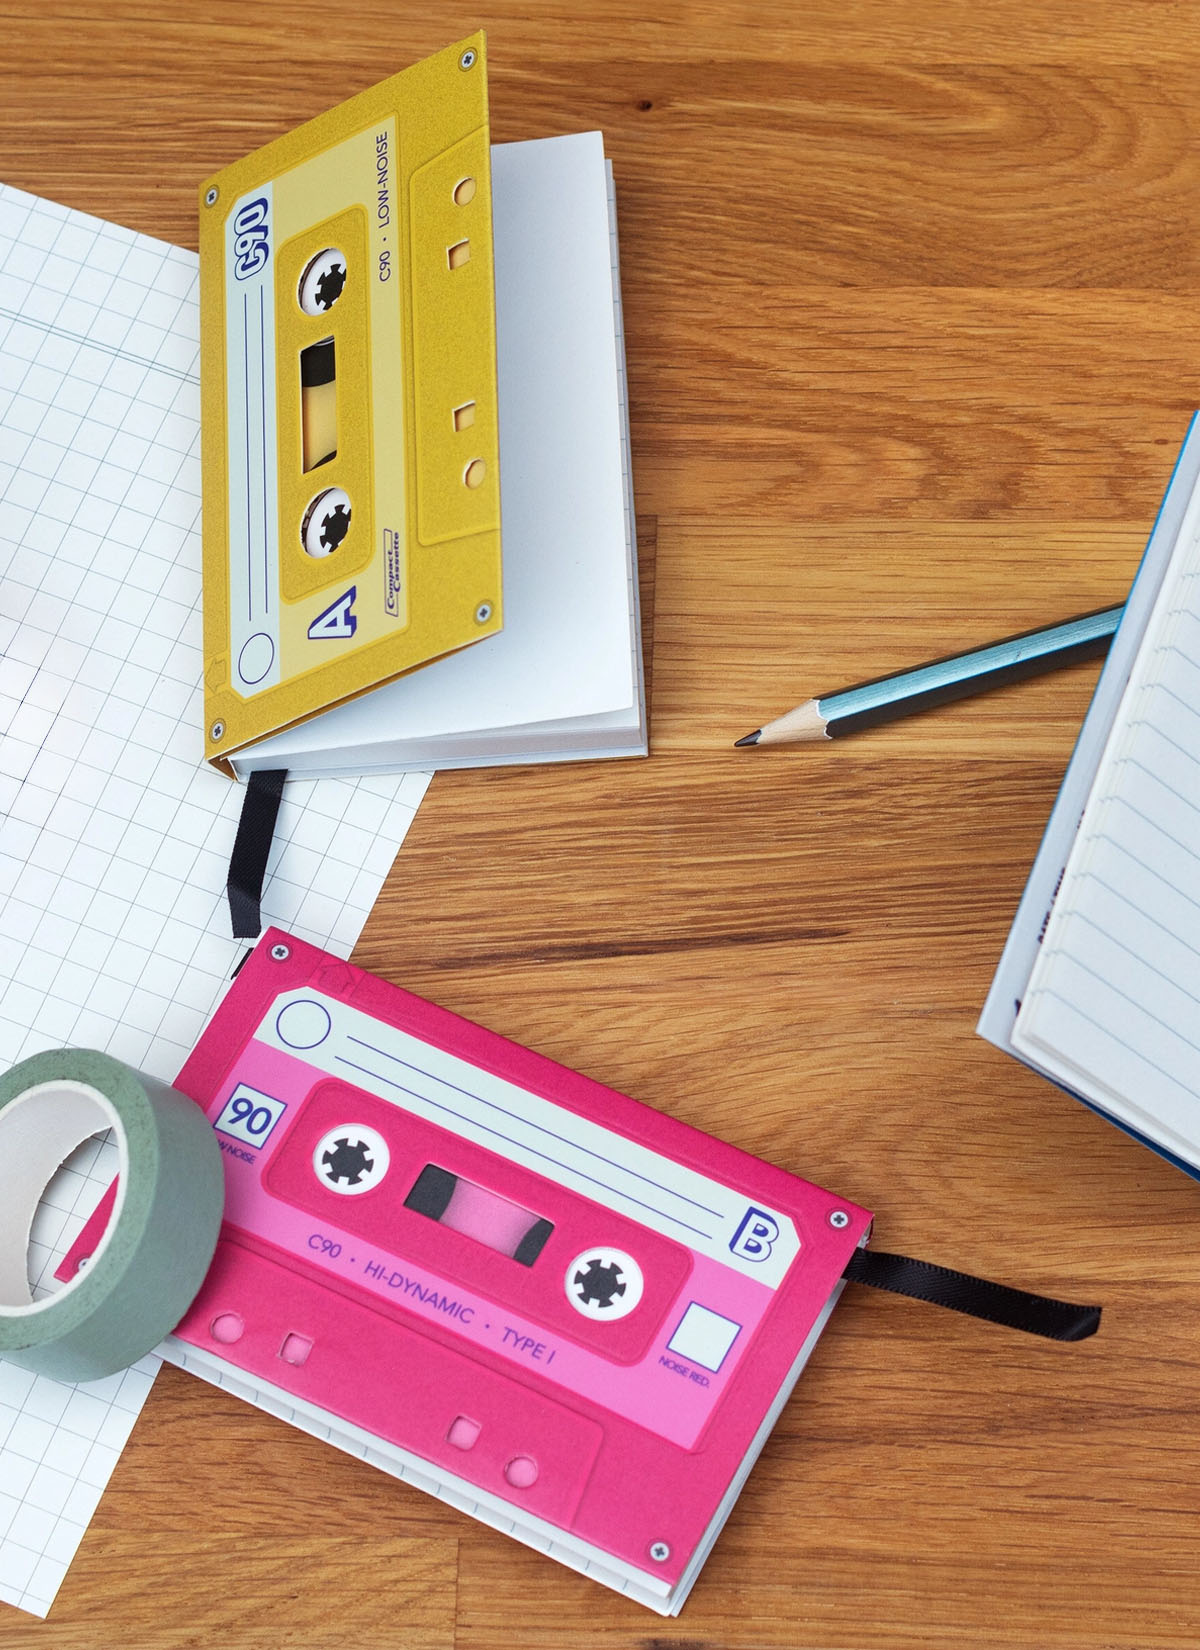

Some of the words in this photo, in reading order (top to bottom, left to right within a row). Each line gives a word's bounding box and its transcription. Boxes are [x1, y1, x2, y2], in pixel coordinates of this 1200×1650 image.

[376, 131, 390, 229] LOW-NOISE
[233, 197, 269, 281] C90
[378, 250, 391, 282] C90
[387, 550, 395, 609] Compact
[393, 531, 401, 592] Cassette
[307, 585, 357, 639] A
[228, 1097, 271, 1135] 90
[227, 1144, 256, 1165] NOISE
[729, 1206, 779, 1262] B
[307, 1233, 342, 1258] C90
[364, 1260, 475, 1324] HI-DYNAMIC
[502, 1326, 547, 1360] TYPE
[658, 1355, 690, 1378] NOISE
